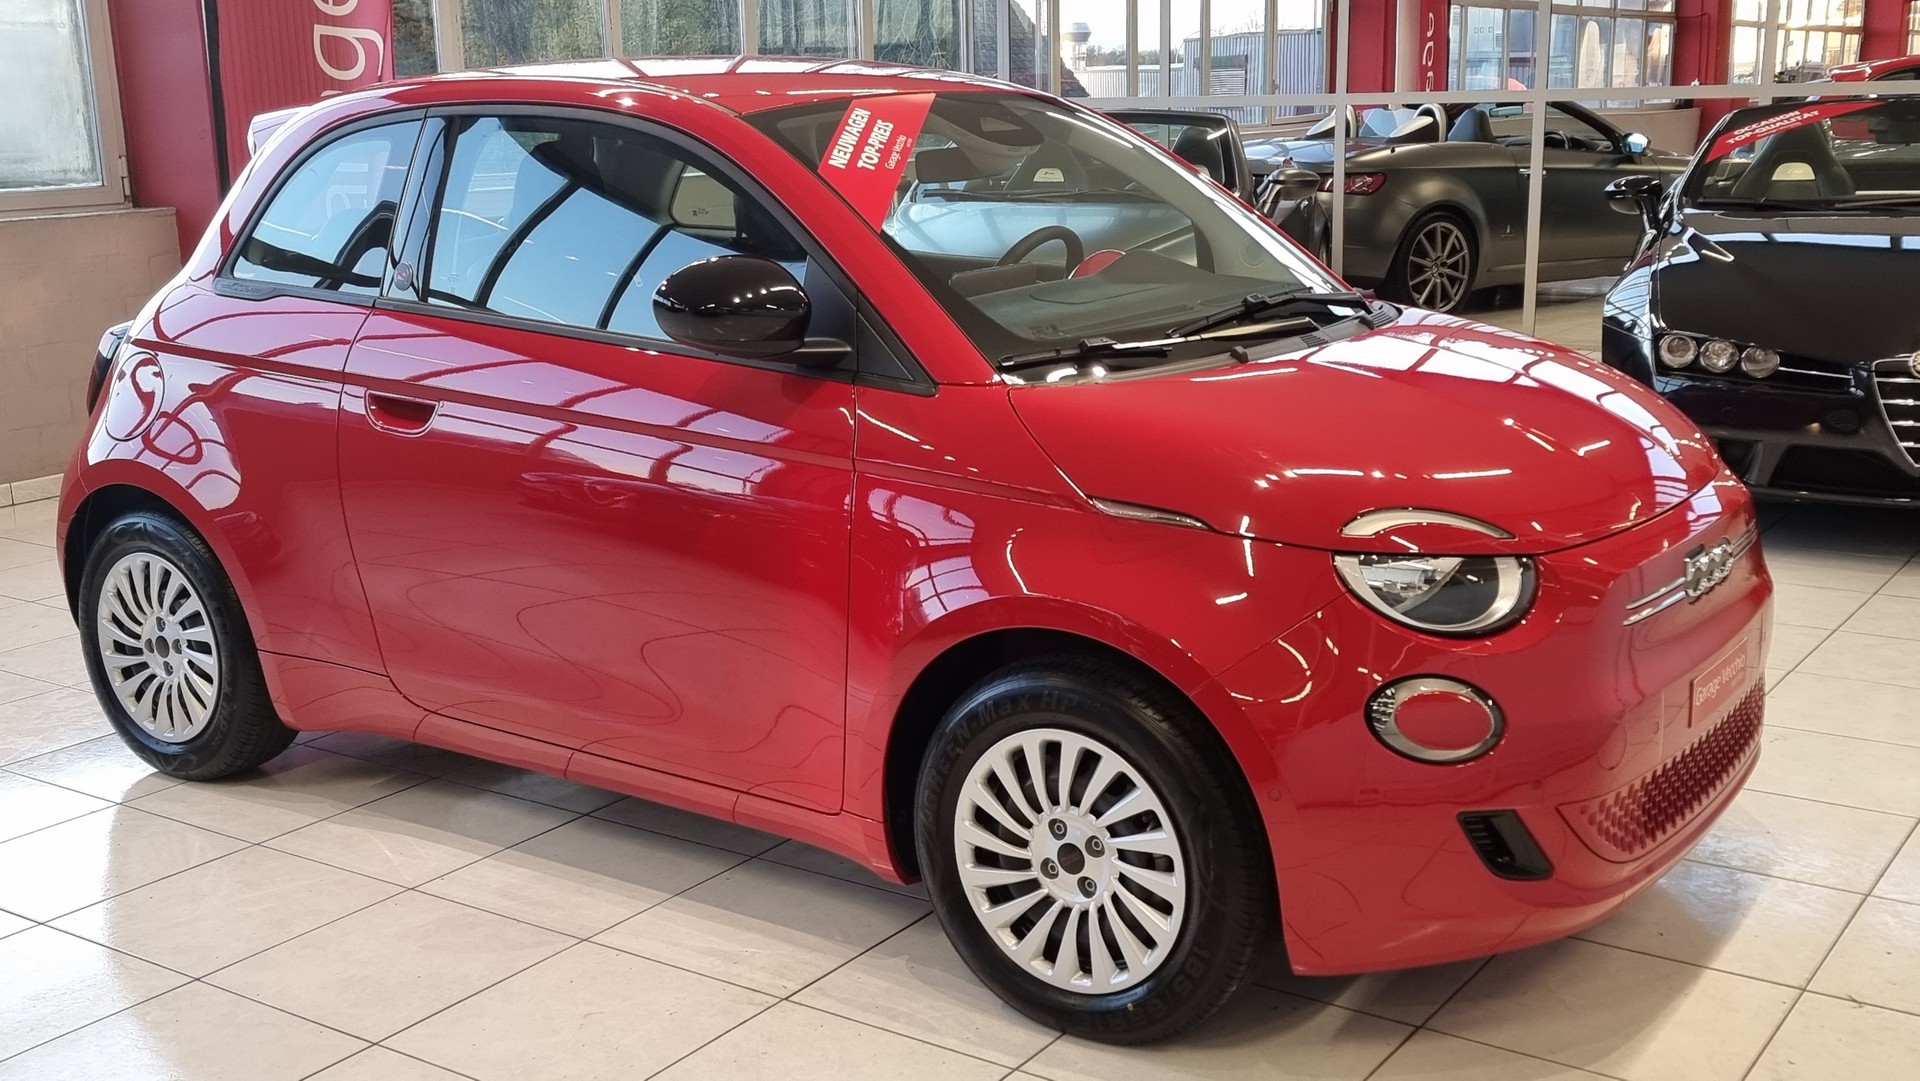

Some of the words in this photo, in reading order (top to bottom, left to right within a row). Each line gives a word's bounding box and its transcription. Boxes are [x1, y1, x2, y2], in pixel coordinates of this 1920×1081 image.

[828, 107, 871, 169] NEUWAGEN
[1733, 110, 1801, 135] OCCASION
[857, 119, 894, 170] TOP-PREIS
[1695, 676, 1721, 705] Garage
